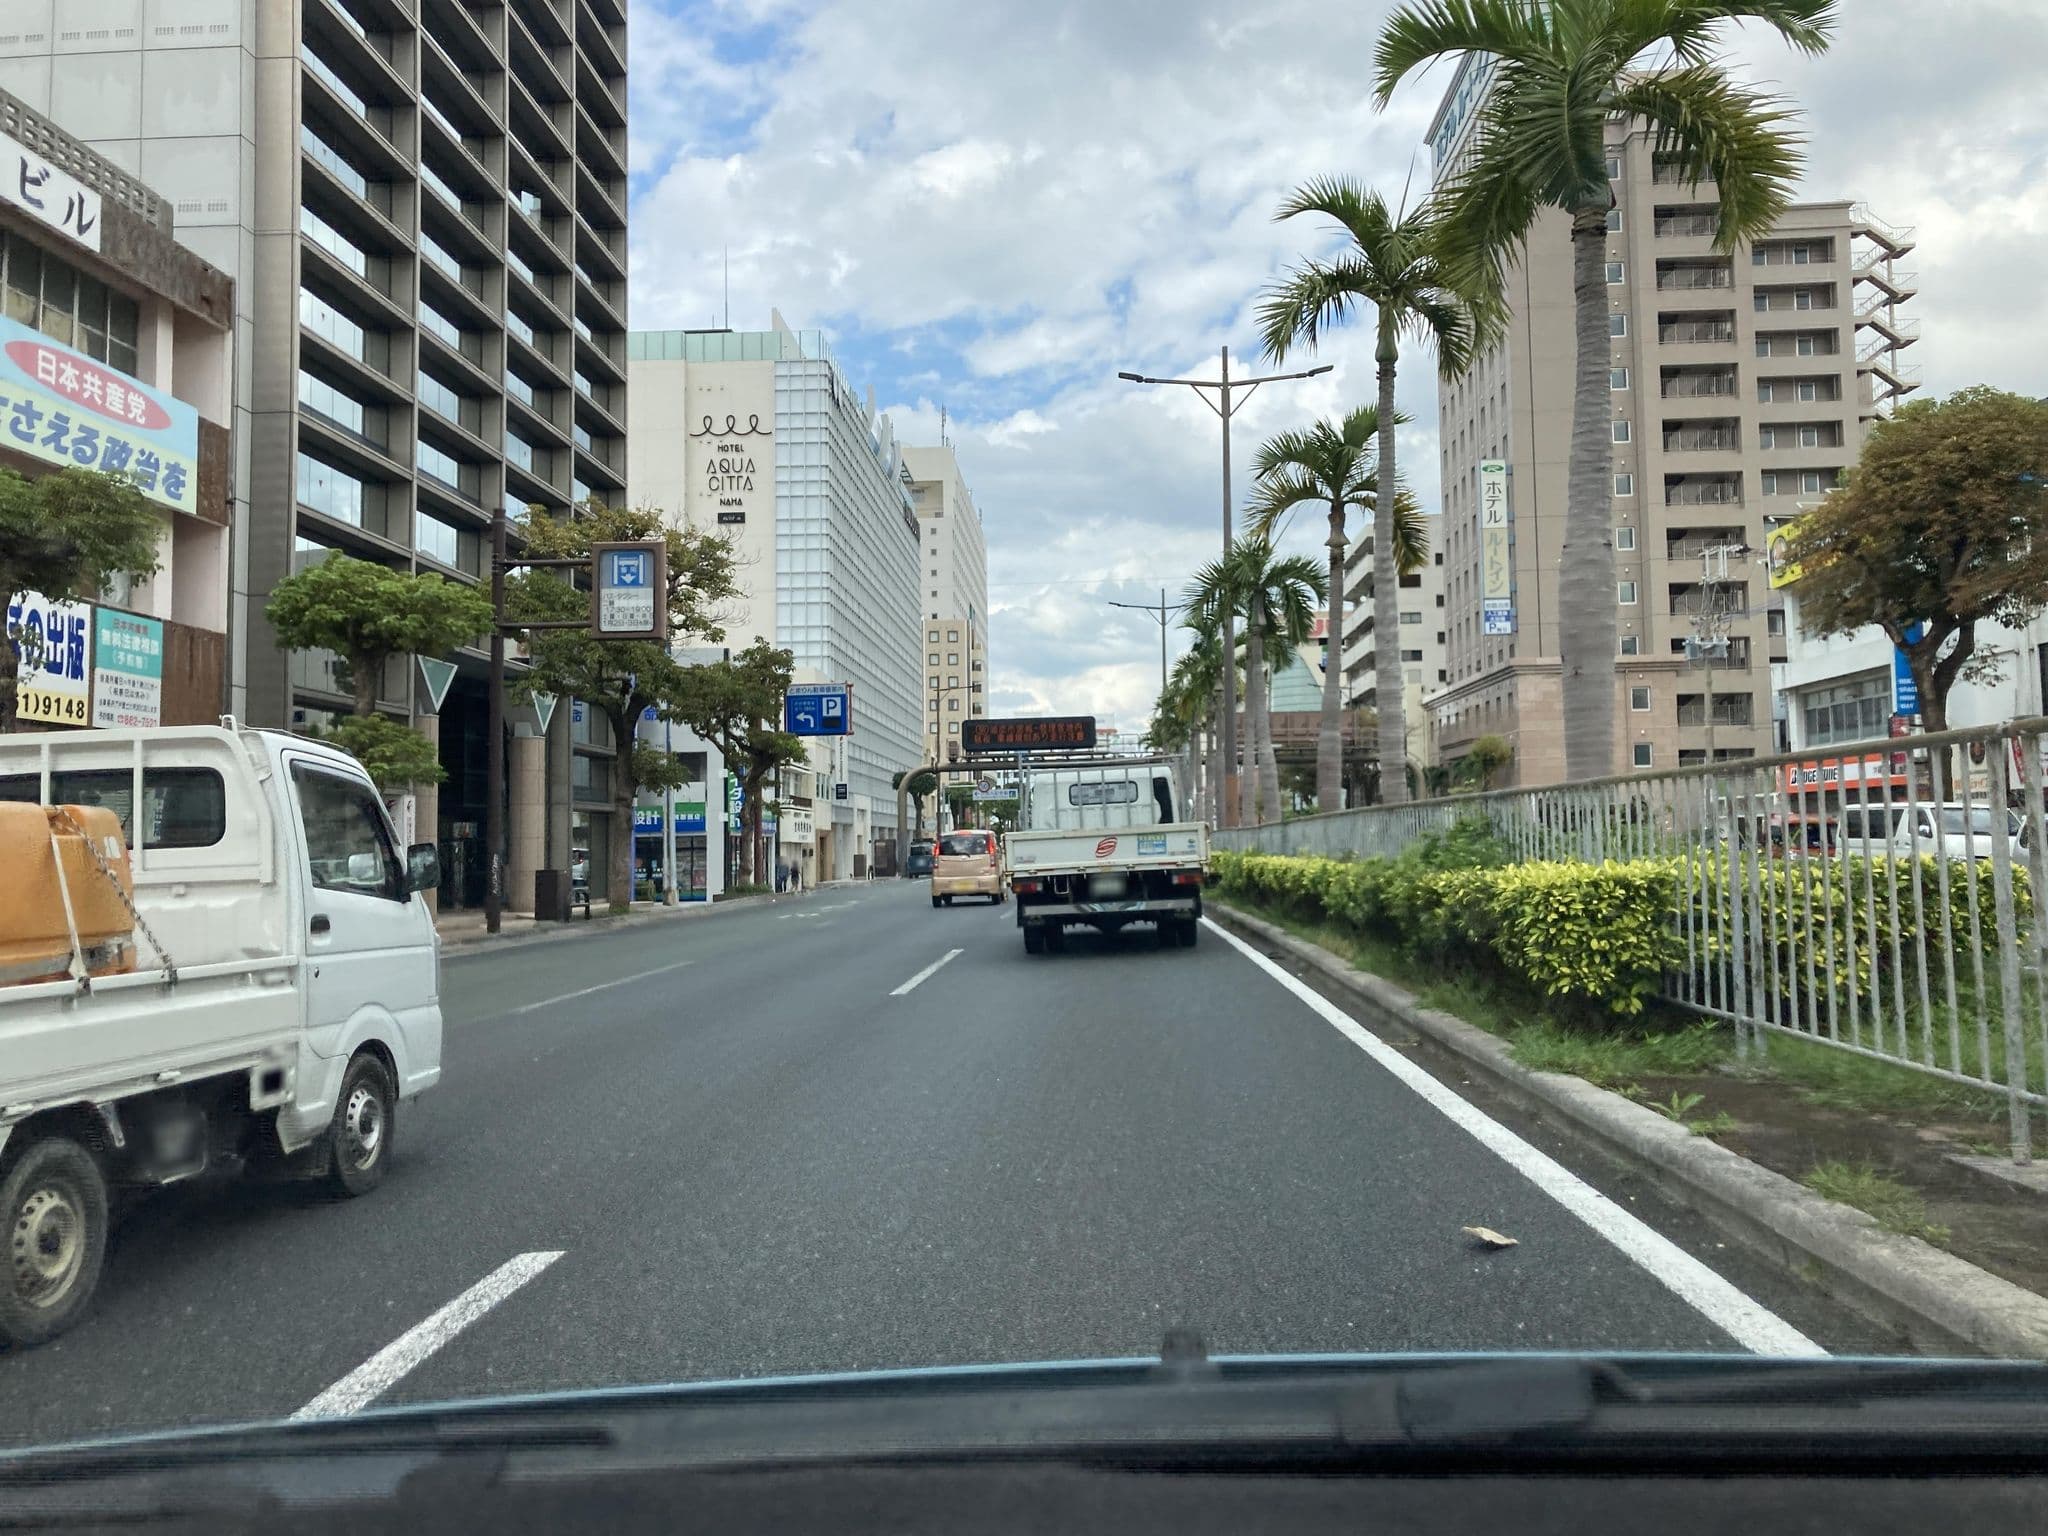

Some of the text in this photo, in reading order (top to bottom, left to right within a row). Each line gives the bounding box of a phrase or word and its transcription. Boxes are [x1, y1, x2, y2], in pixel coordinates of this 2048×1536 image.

[20, 156, 96, 236] ビル
[37, 349, 146, 425] 日本共産党
[0, 396, 187, 501] さえる政治を
[717, 444, 744, 453] HOTEL
[706, 457, 756, 474] AQUA
[708, 475, 753, 491] CITTA
[719, 498, 743, 506] NAHA
[1486, 480, 1503, 525] ホテル
[1488, 532, 1504, 594] ルートイン
[826, 698, 837, 715] P
